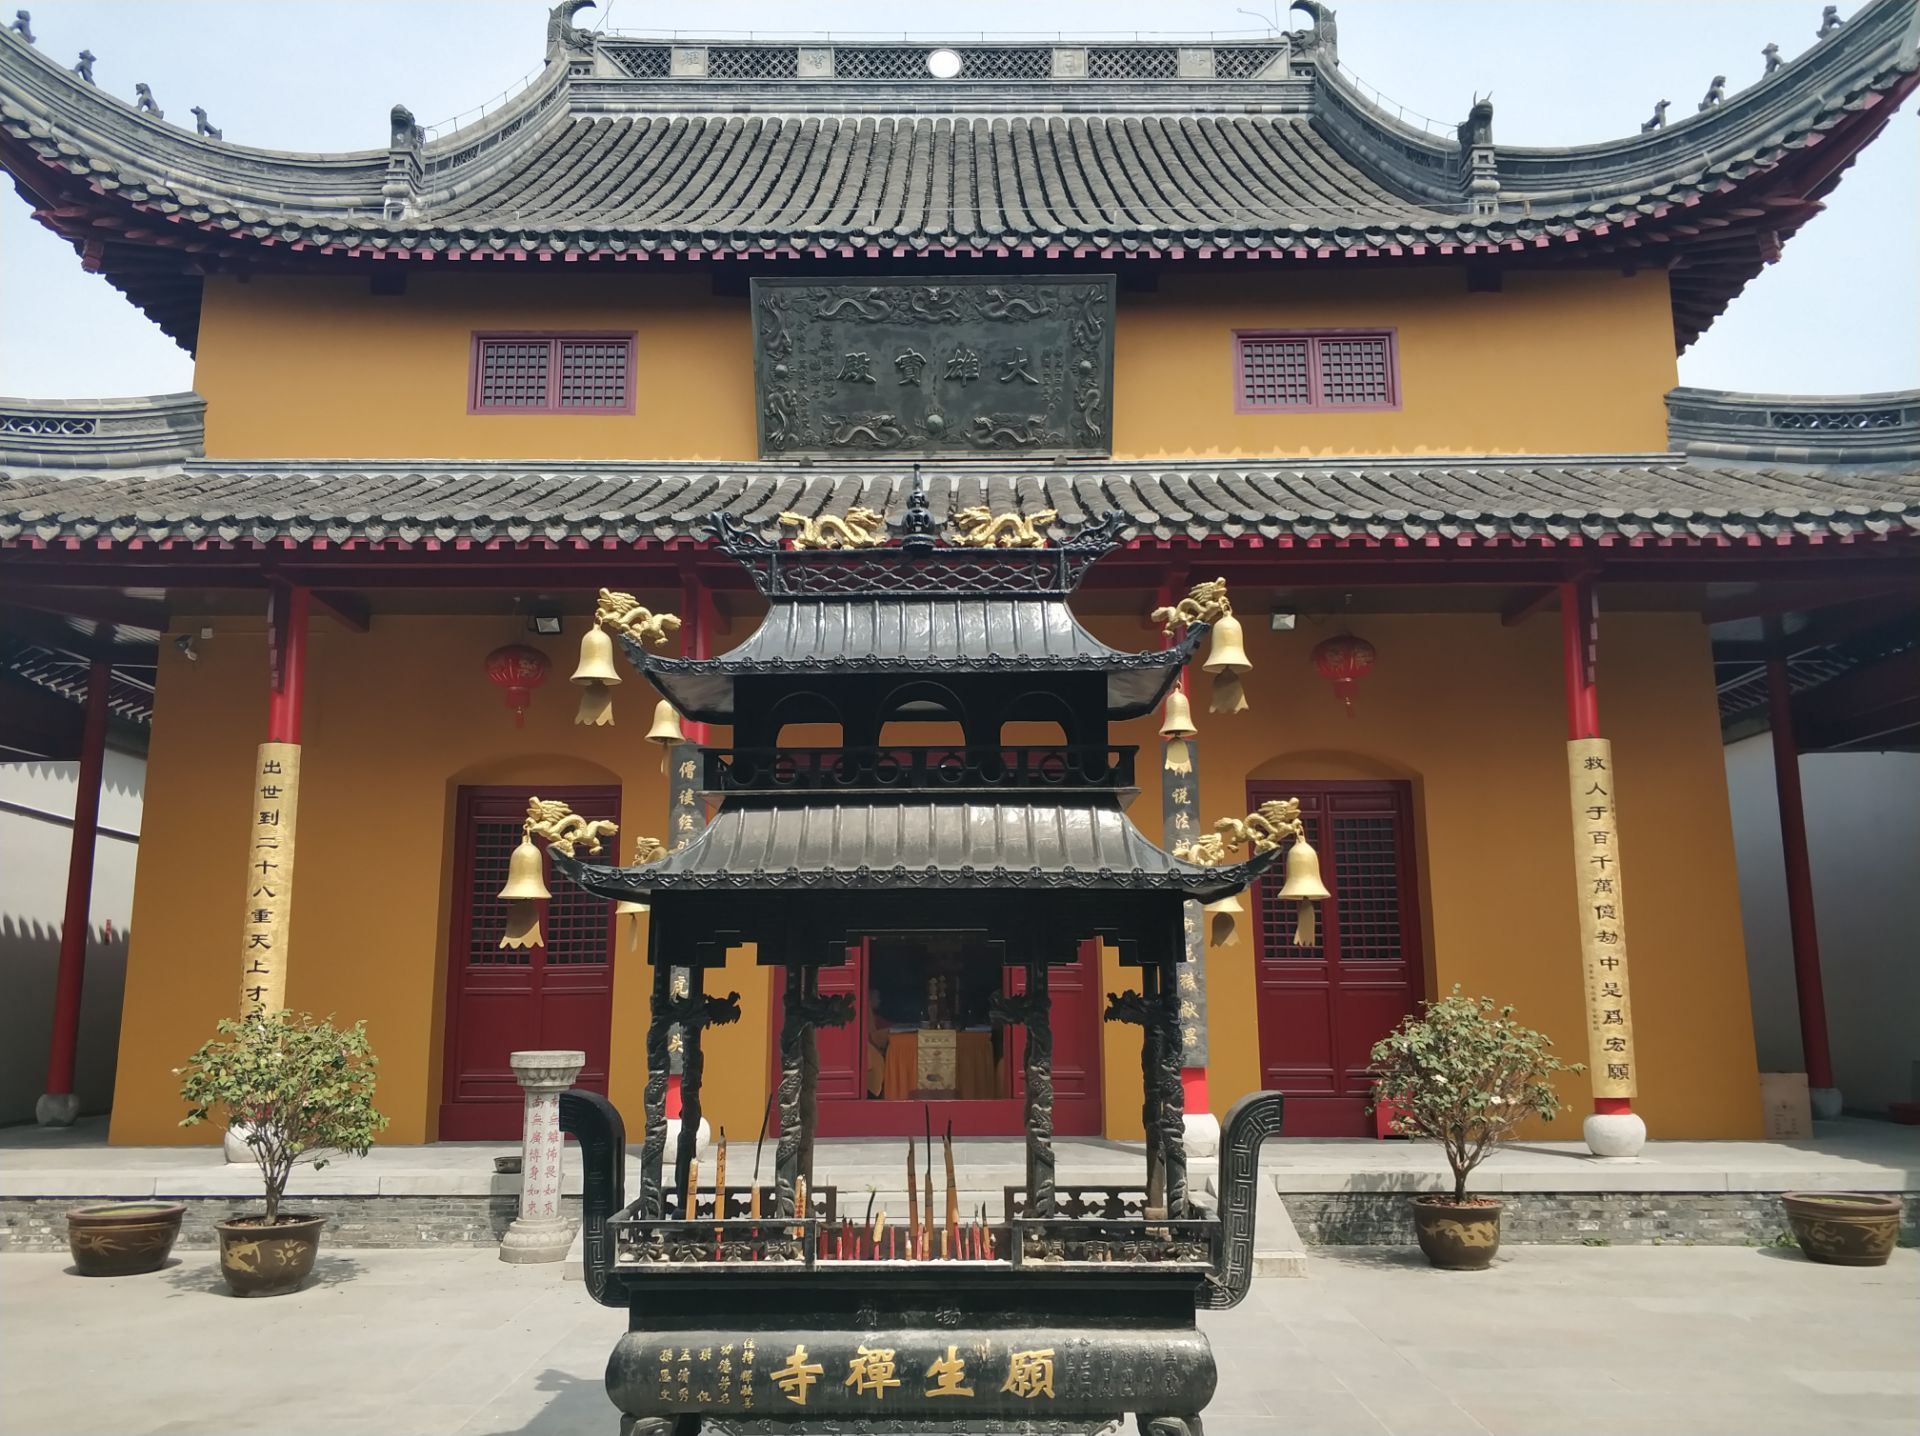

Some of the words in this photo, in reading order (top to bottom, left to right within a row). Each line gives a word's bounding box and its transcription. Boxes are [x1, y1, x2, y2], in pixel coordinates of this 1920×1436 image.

[838, 347, 1040, 385] 大雄寶殿
[716, 1343, 734, 1405] 功德芳名
[770, 1344, 1057, 1405] 願生禪寺
